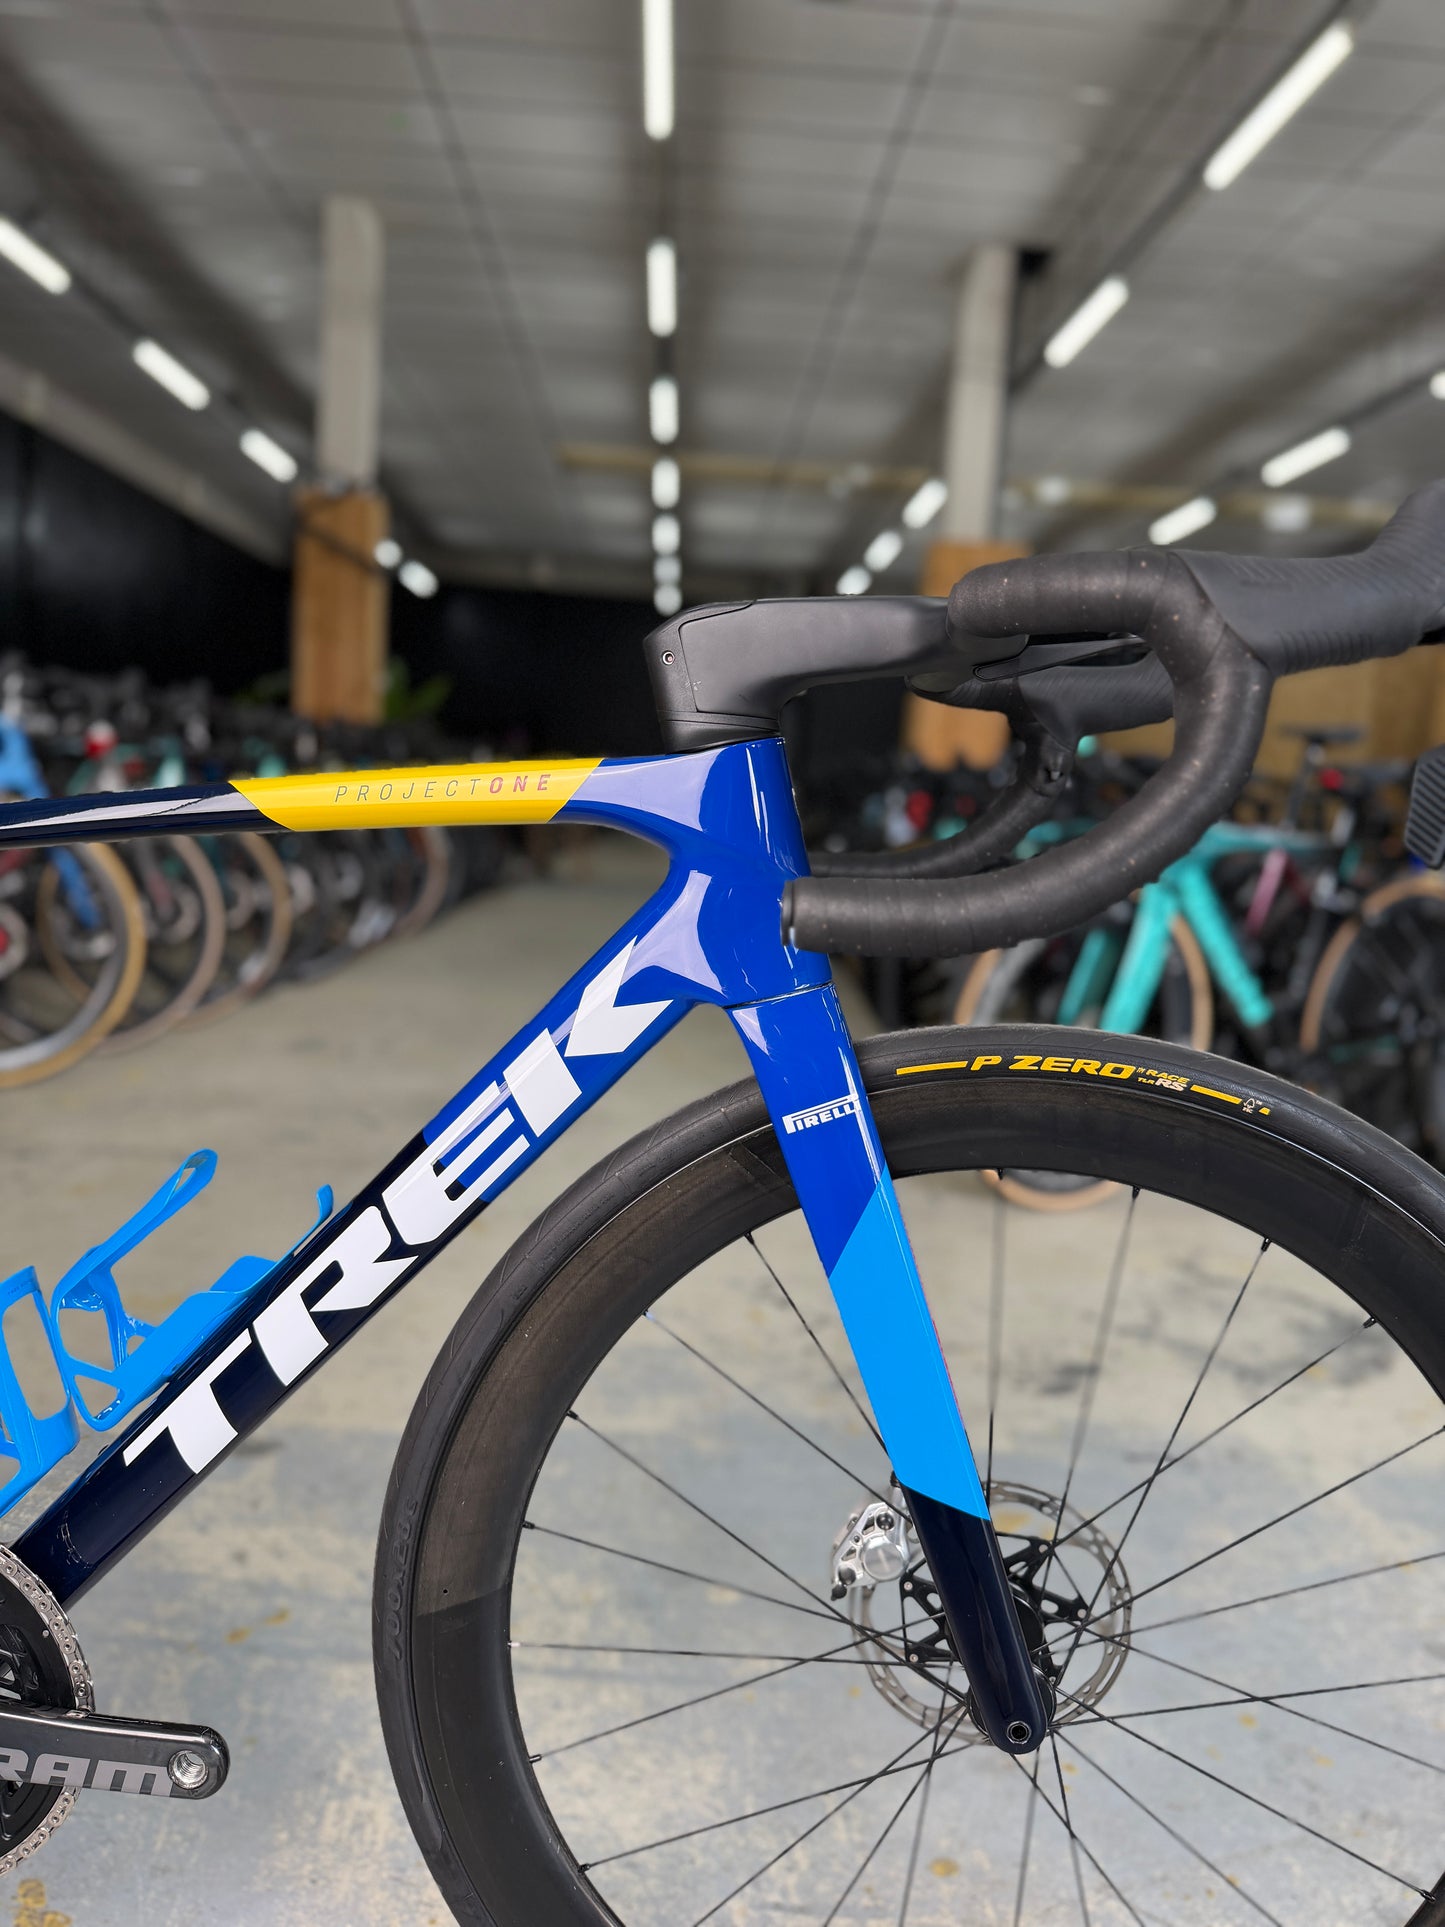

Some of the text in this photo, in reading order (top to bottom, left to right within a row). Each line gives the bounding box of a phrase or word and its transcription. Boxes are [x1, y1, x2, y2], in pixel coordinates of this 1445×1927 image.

[970, 1055, 1190, 1084] P ZERO RACE
[1154, 1077, 1188, 1092] RS
[123, 935, 674, 1475] TREK
